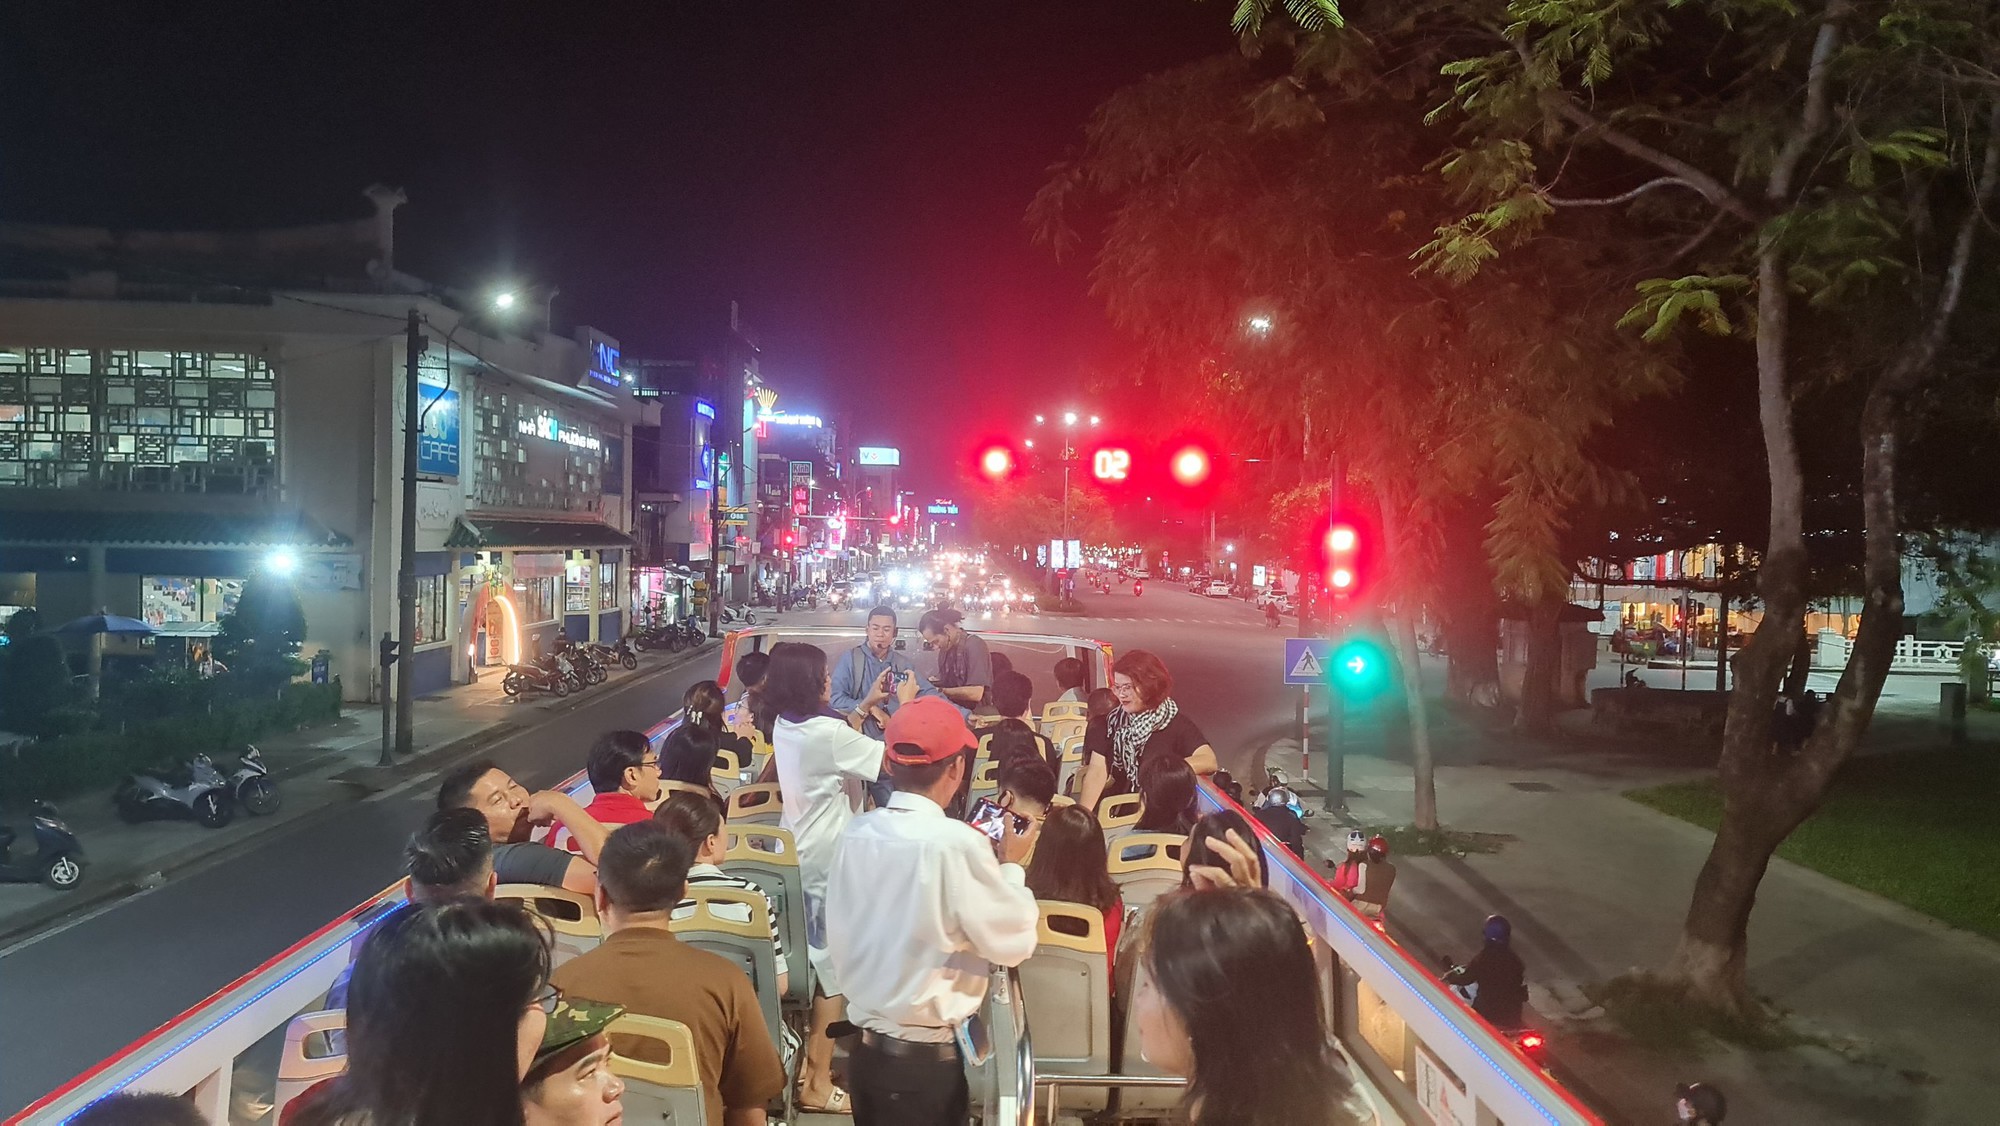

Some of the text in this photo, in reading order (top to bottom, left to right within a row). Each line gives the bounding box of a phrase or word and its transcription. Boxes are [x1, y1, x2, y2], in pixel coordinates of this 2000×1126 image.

[518, 417, 536, 436] NHÀ
[537, 409, 558, 441] SÁCH
[420, 440, 457, 464] CAFE
[1094, 449, 1130, 479] 02
